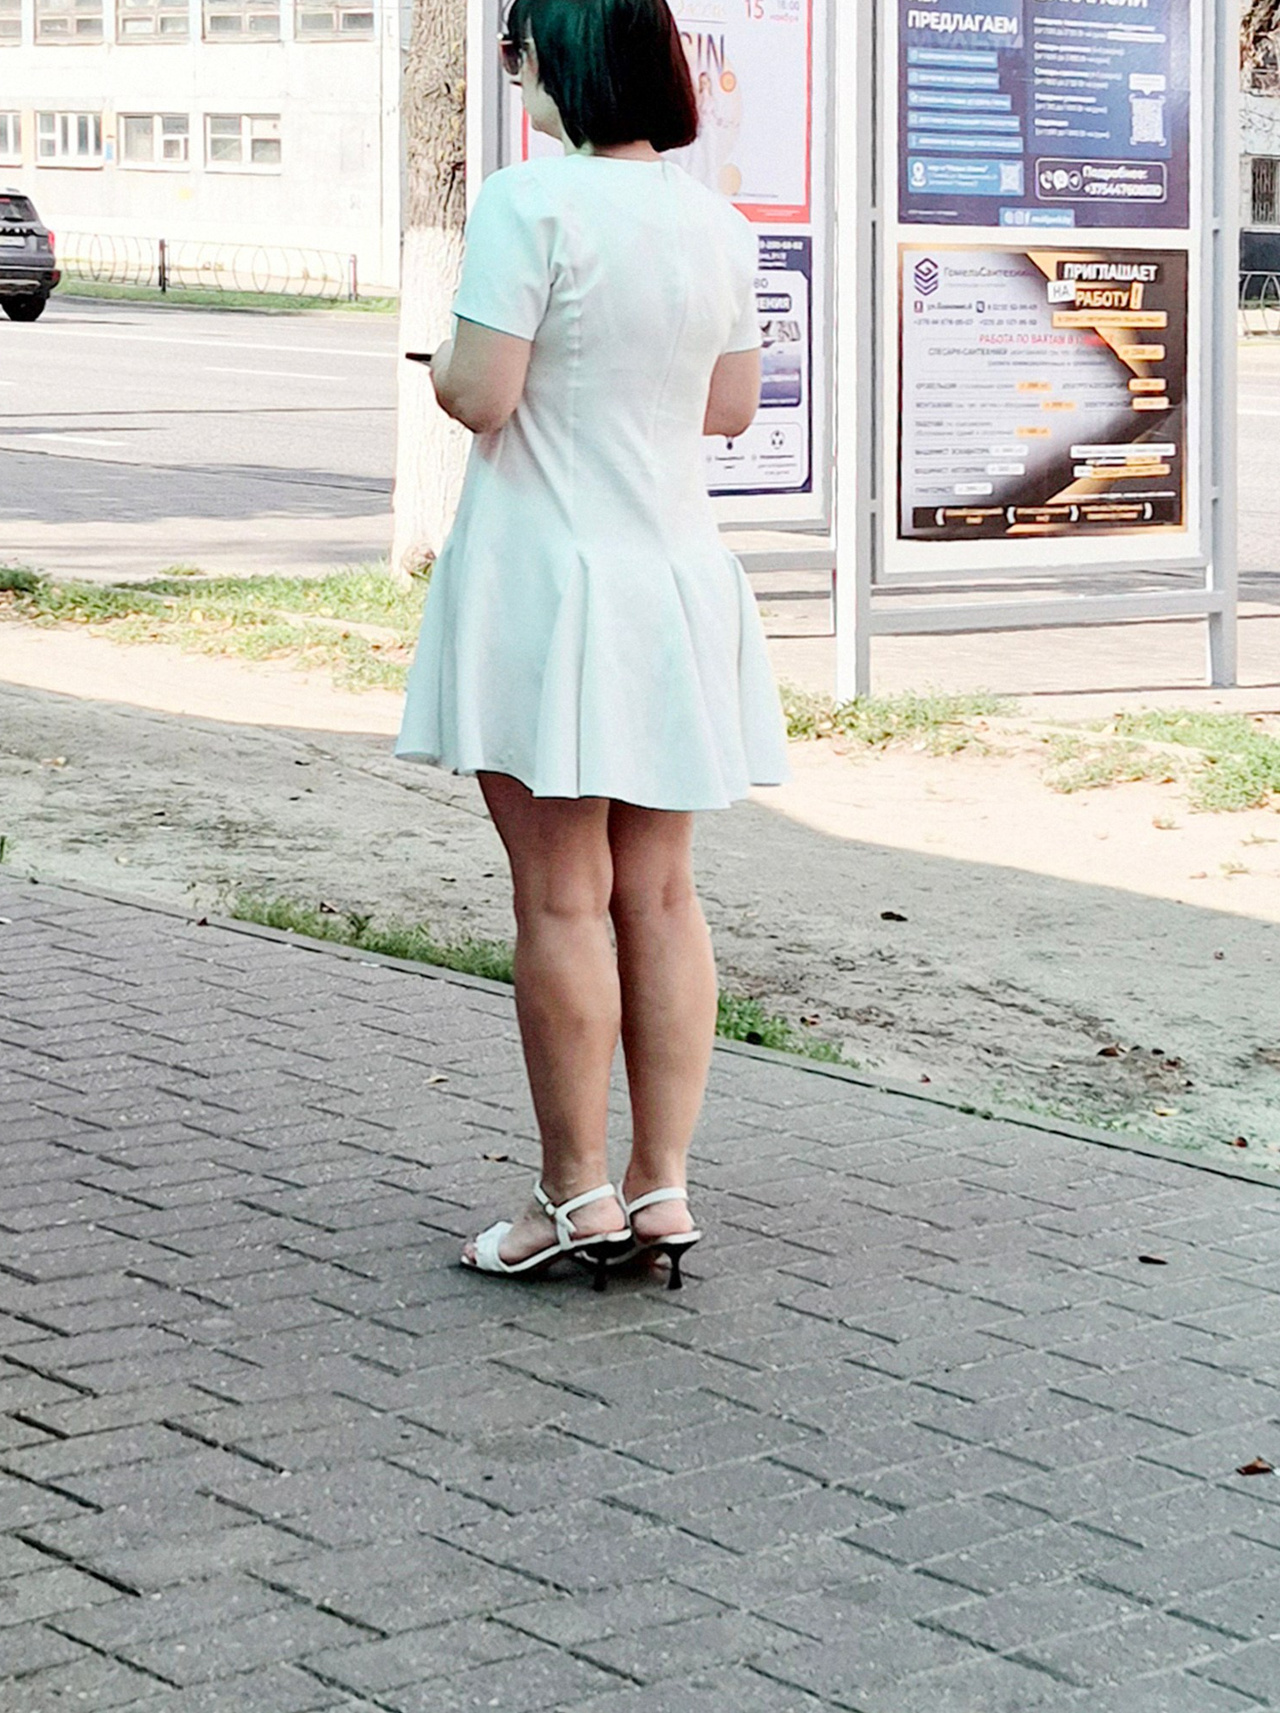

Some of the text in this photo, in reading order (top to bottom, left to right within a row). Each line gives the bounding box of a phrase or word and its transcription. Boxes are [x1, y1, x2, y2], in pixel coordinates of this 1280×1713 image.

[907, 9, 1018, 35] ПРЕДЛАГАЕМ
[680, 31, 725, 74] IN
[1063, 262, 1158, 282] ПРИГЛАШАЕТ
[1052, 284, 1071, 298] НА
